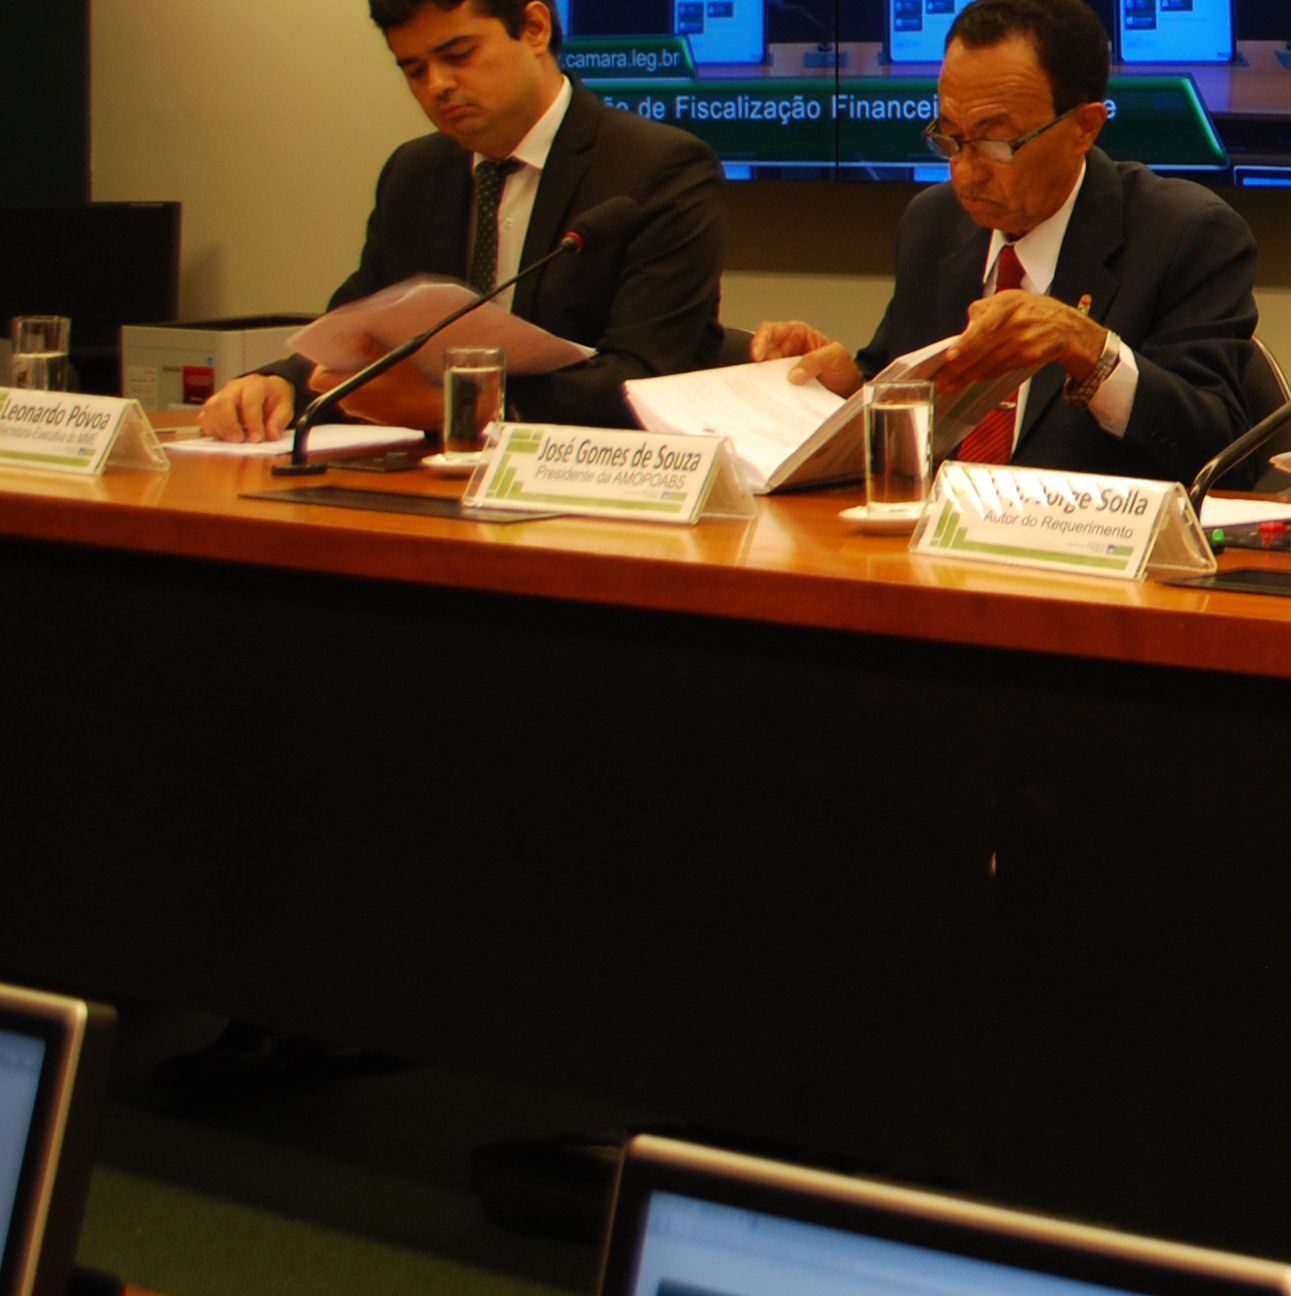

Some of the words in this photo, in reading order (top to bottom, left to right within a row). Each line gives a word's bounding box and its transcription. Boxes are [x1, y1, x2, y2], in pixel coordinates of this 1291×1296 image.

[561, 49, 681, 71] .camara.leg.br
[638, 96, 666, 119] de
[676, 95, 821, 124] Fiscalização
[831, 95, 939, 119] Financei
[1, 399, 67, 426] Leonardo
[66, 405, 112, 430] Póvoa
[538, 436, 577, 462] José
[576, 439, 628, 468] Gomes
[631, 442, 652, 468] de
[653, 445, 702, 472] Souza
[535, 465, 595, 484] Presidente
[596, 469, 613, 485] da
[1036, 484, 1092, 515] orge
[1095, 487, 1149, 516] Solla
[983, 510, 1019, 526] Autor
[1021, 513, 1038, 528] do
[1040, 516, 1134, 540] Requerimento
